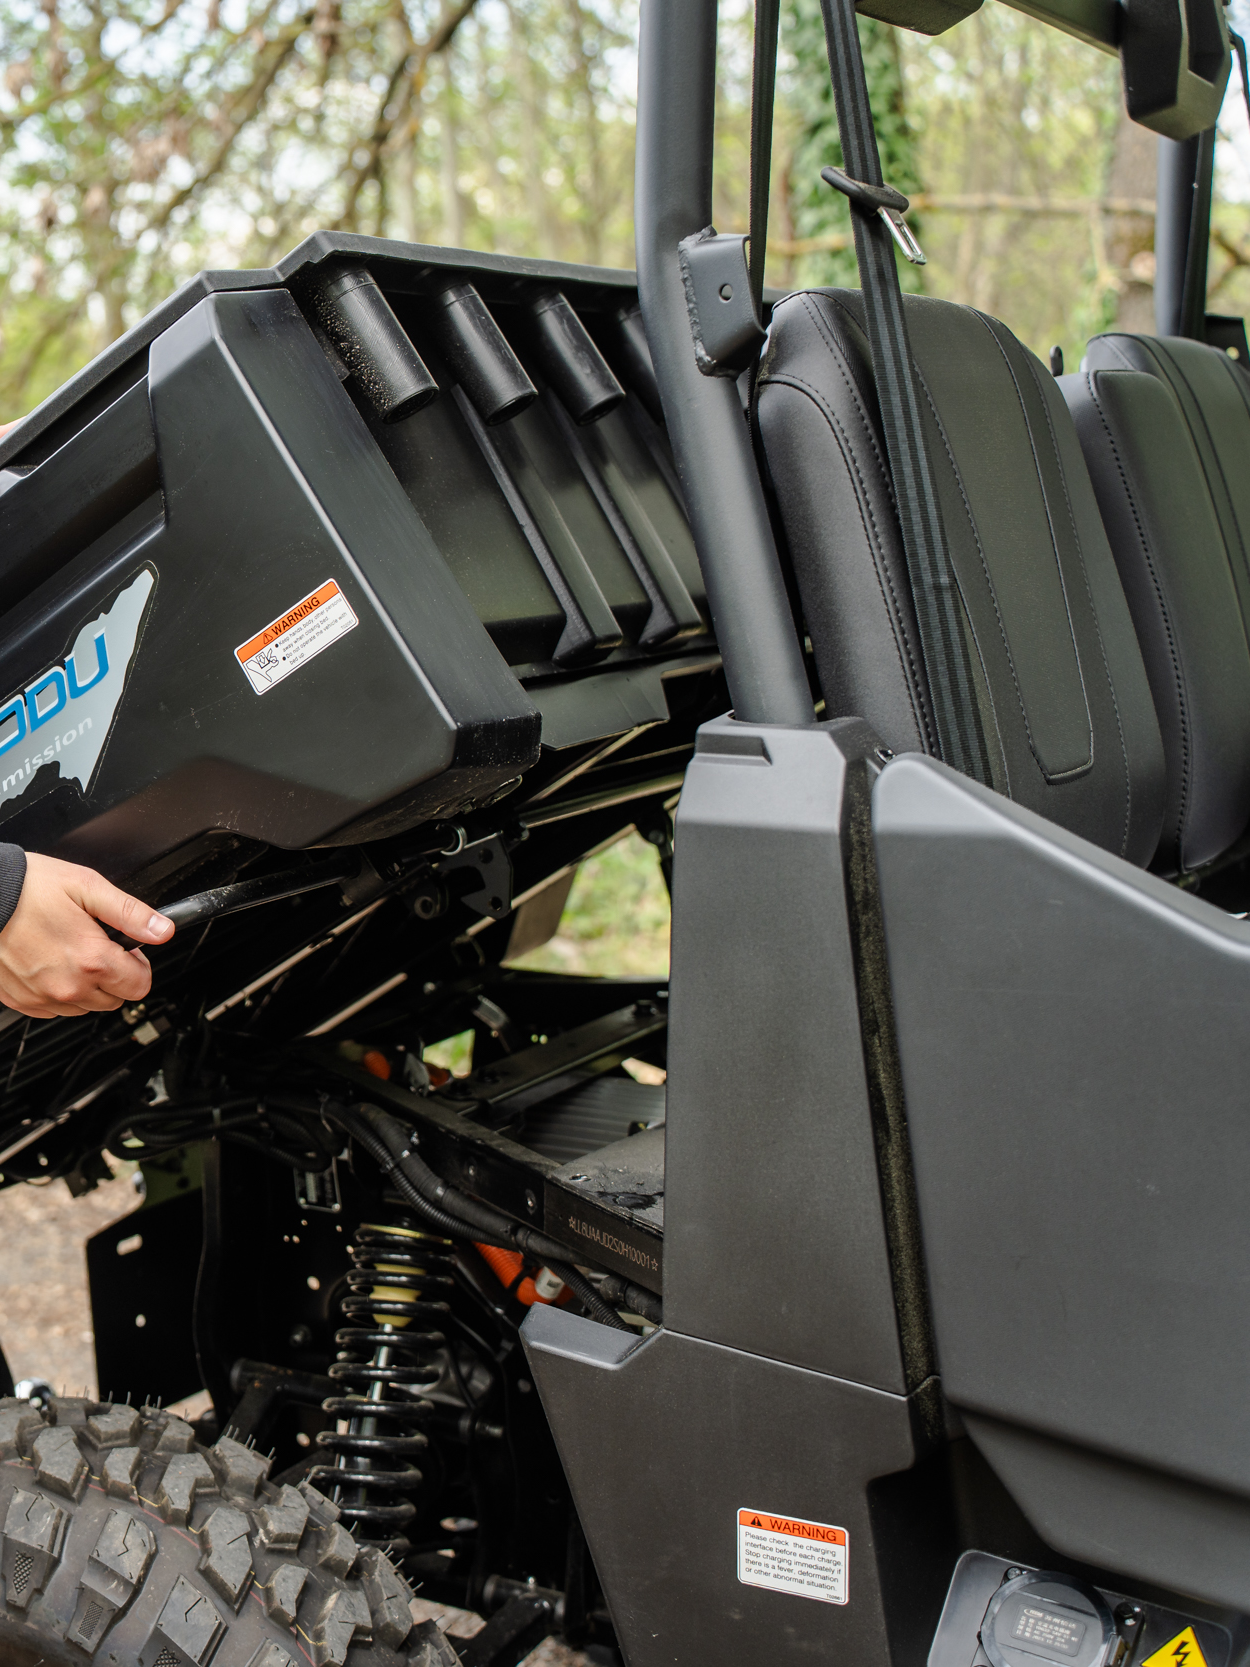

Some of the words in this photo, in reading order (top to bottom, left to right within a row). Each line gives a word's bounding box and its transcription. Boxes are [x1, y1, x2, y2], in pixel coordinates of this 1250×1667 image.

[271, 596, 320, 636] WARNING
[278, 636, 290, 646] Keep
[314, 610, 325, 620] other
[325, 598, 342, 613] persons
[283, 643, 294, 652] away
[293, 635, 305, 644] when
[305, 623, 320, 636] closing
[300, 634, 316, 648] operate
[324, 618, 338, 631] vehicle
[338, 612, 347, 621] with
[290, 657, 299, 665] bed
[770, 1519, 836, 1542] WARNING
[745, 1532, 767, 1542] Please
[806, 1544, 836, 1557] charging
[745, 1541, 773, 1552] interface
[775, 1547, 797, 1557] before
[818, 1556, 843, 1567] charge.
[745, 1549, 760, 1558] Stop
[763, 1553, 792, 1565] charging
[794, 1560, 834, 1574] immediately
[745, 1558, 762, 1566] there
[777, 1565, 795, 1574] fever,
[798, 1570, 838, 1582] deformation
[754, 1569, 771, 1577] other
[773, 1573, 804, 1584] abnormal
[806, 1579, 837, 1591] situation.
